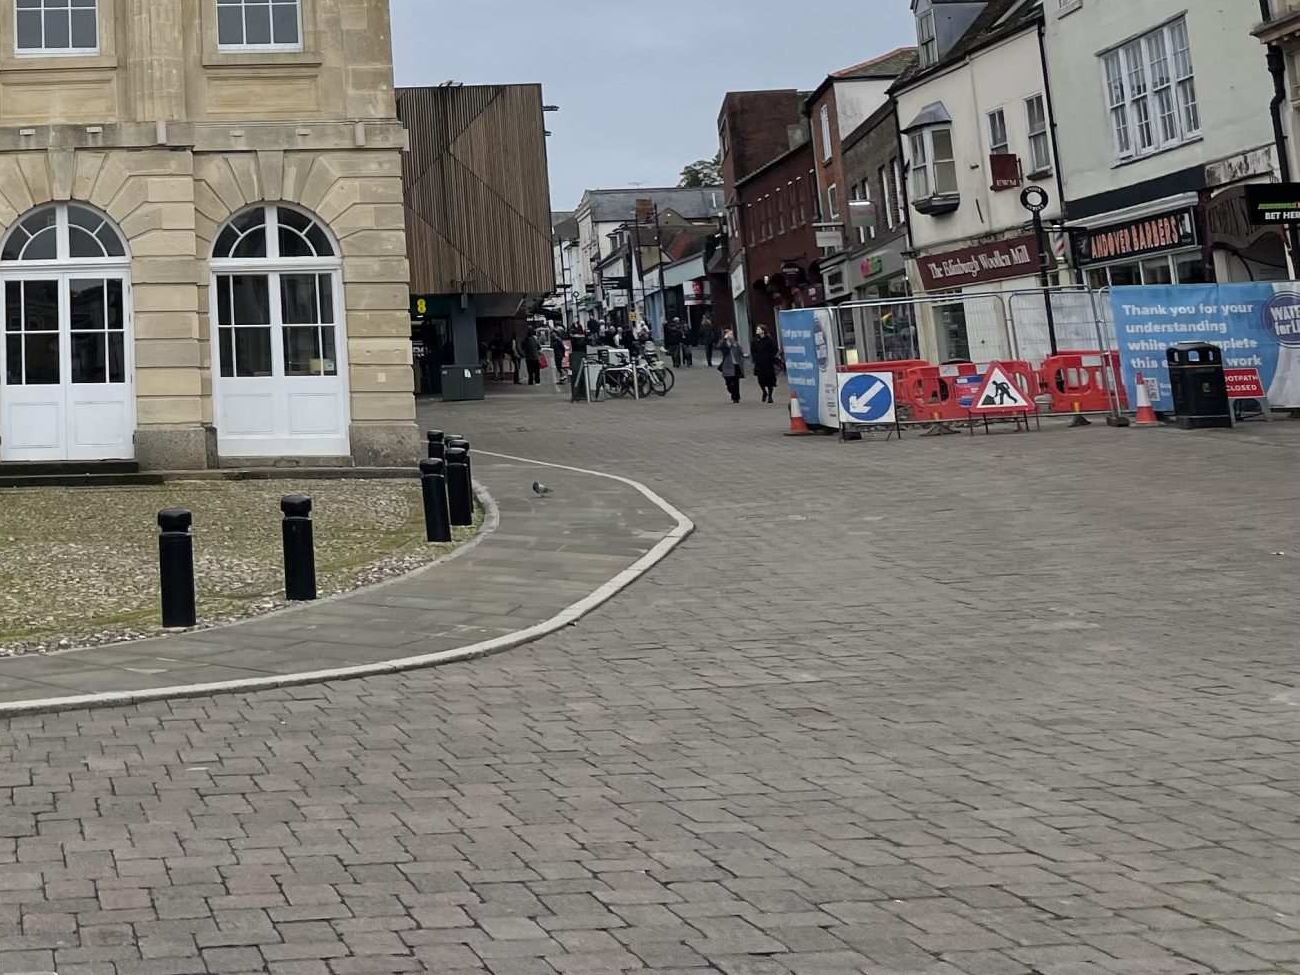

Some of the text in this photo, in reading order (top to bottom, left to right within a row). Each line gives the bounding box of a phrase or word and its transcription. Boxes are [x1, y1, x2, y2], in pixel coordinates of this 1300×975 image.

[996, 179, 1017, 187] EWM
[1264, 211, 1282, 221] BET
[1090, 228, 1132, 259] ANDOVER
[1131, 215, 1179, 251] BARBERS
[927, 244, 1031, 279] The Edinburgh Woollen Mill
[1122, 303, 1254, 317] Thank you for your
[1125, 321, 1227, 334] understanding
[1127, 338, 1167, 351] while
[1131, 357, 1158, 369] this
[1225, 354, 1262, 367] work
[1225, 384, 1258, 392] CLOSED
